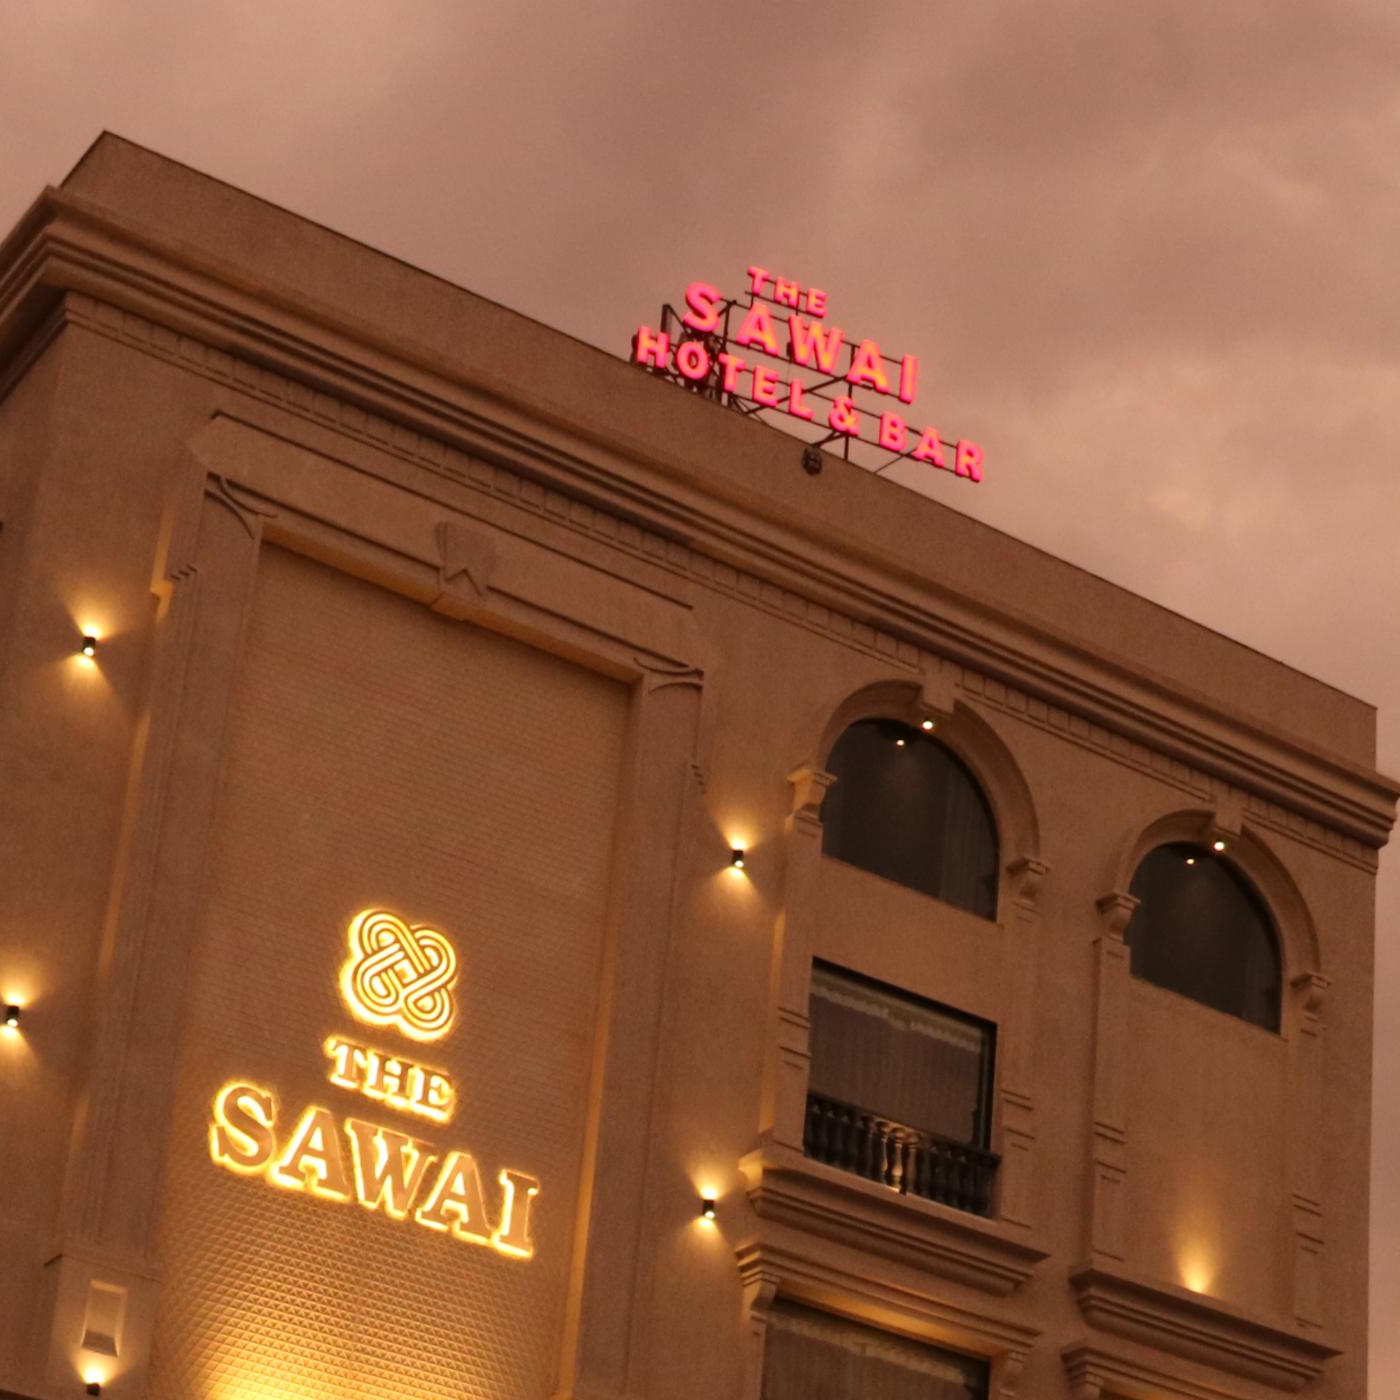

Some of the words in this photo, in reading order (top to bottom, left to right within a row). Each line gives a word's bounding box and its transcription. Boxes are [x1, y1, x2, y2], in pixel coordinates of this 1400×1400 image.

[683, 282, 918, 404] SAWAI
[747, 266, 828, 317] THE
[636, 326, 813, 421] HOTEL
[829, 395, 859, 436] &
[879, 410, 983, 482] BAR
[325, 1036, 455, 1122] THE
[210, 1081, 539, 1258] SAWAI
